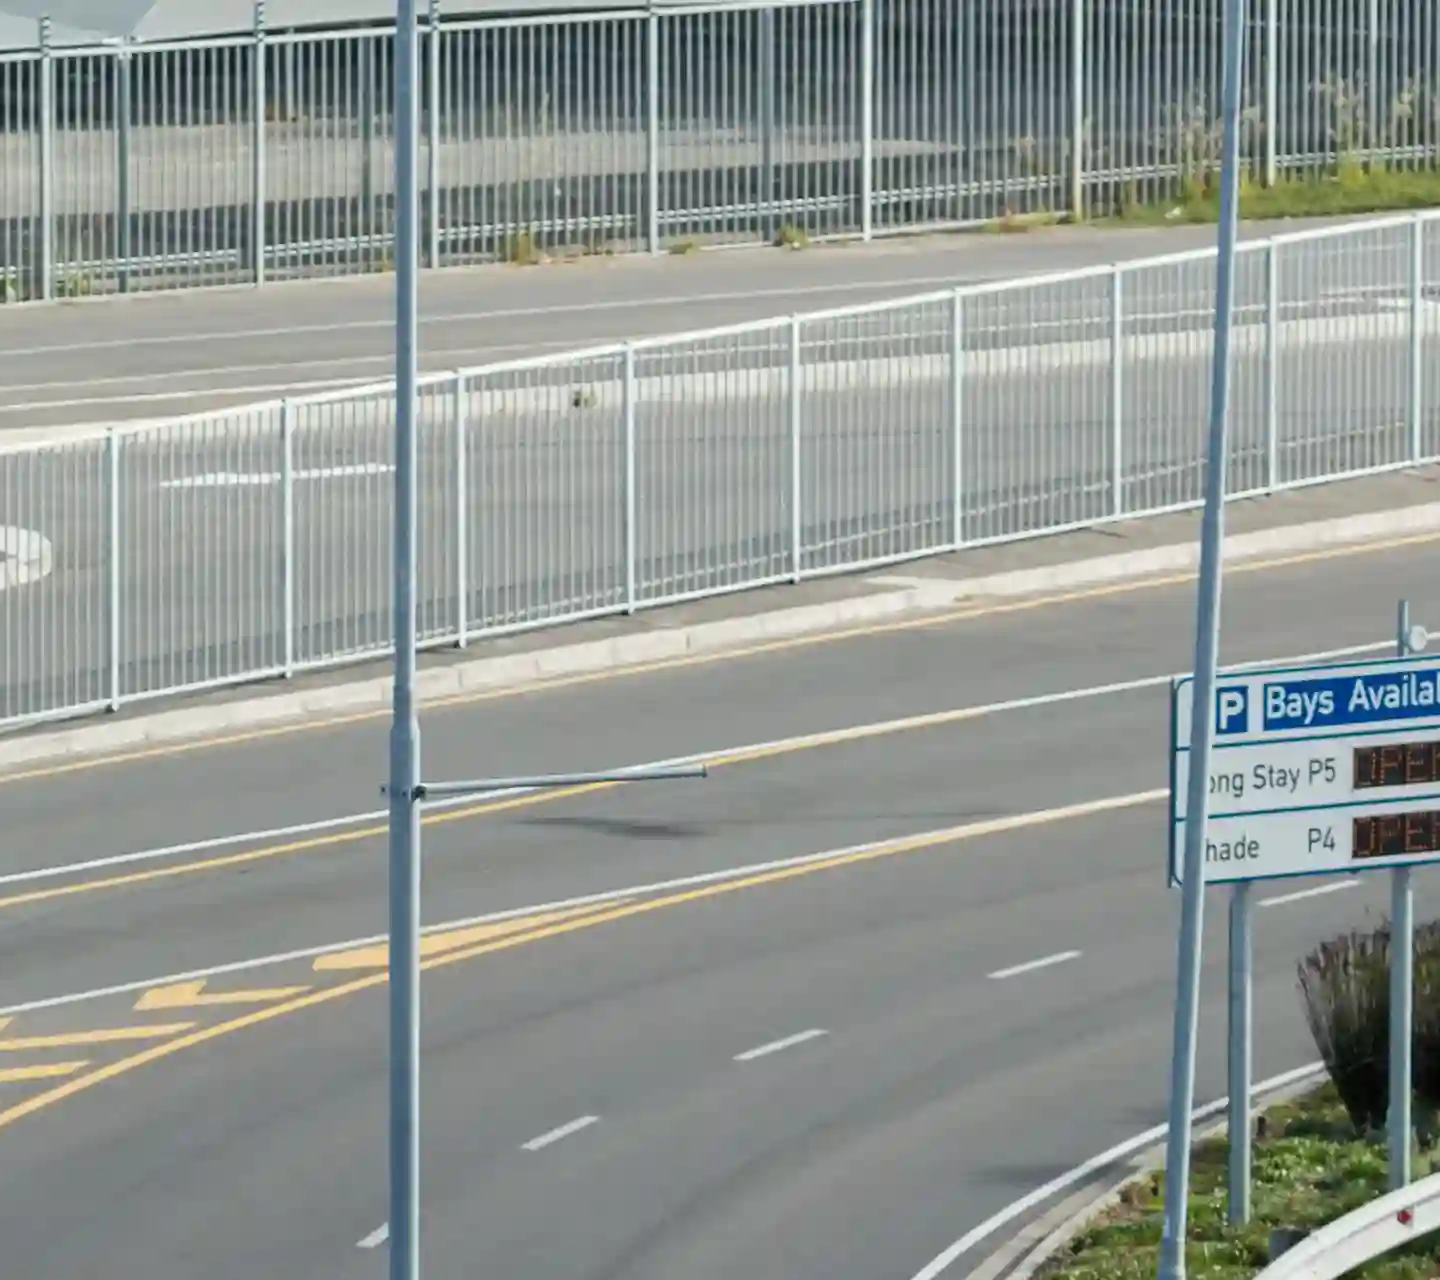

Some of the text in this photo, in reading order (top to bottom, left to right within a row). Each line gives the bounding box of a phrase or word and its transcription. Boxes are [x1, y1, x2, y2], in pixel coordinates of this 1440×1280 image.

[1218, 691, 1245, 730] P
[1266, 685, 1335, 725] Bays
[1209, 757, 1336, 798] ong Stay P5
[1205, 826, 1336, 862] hade P4
